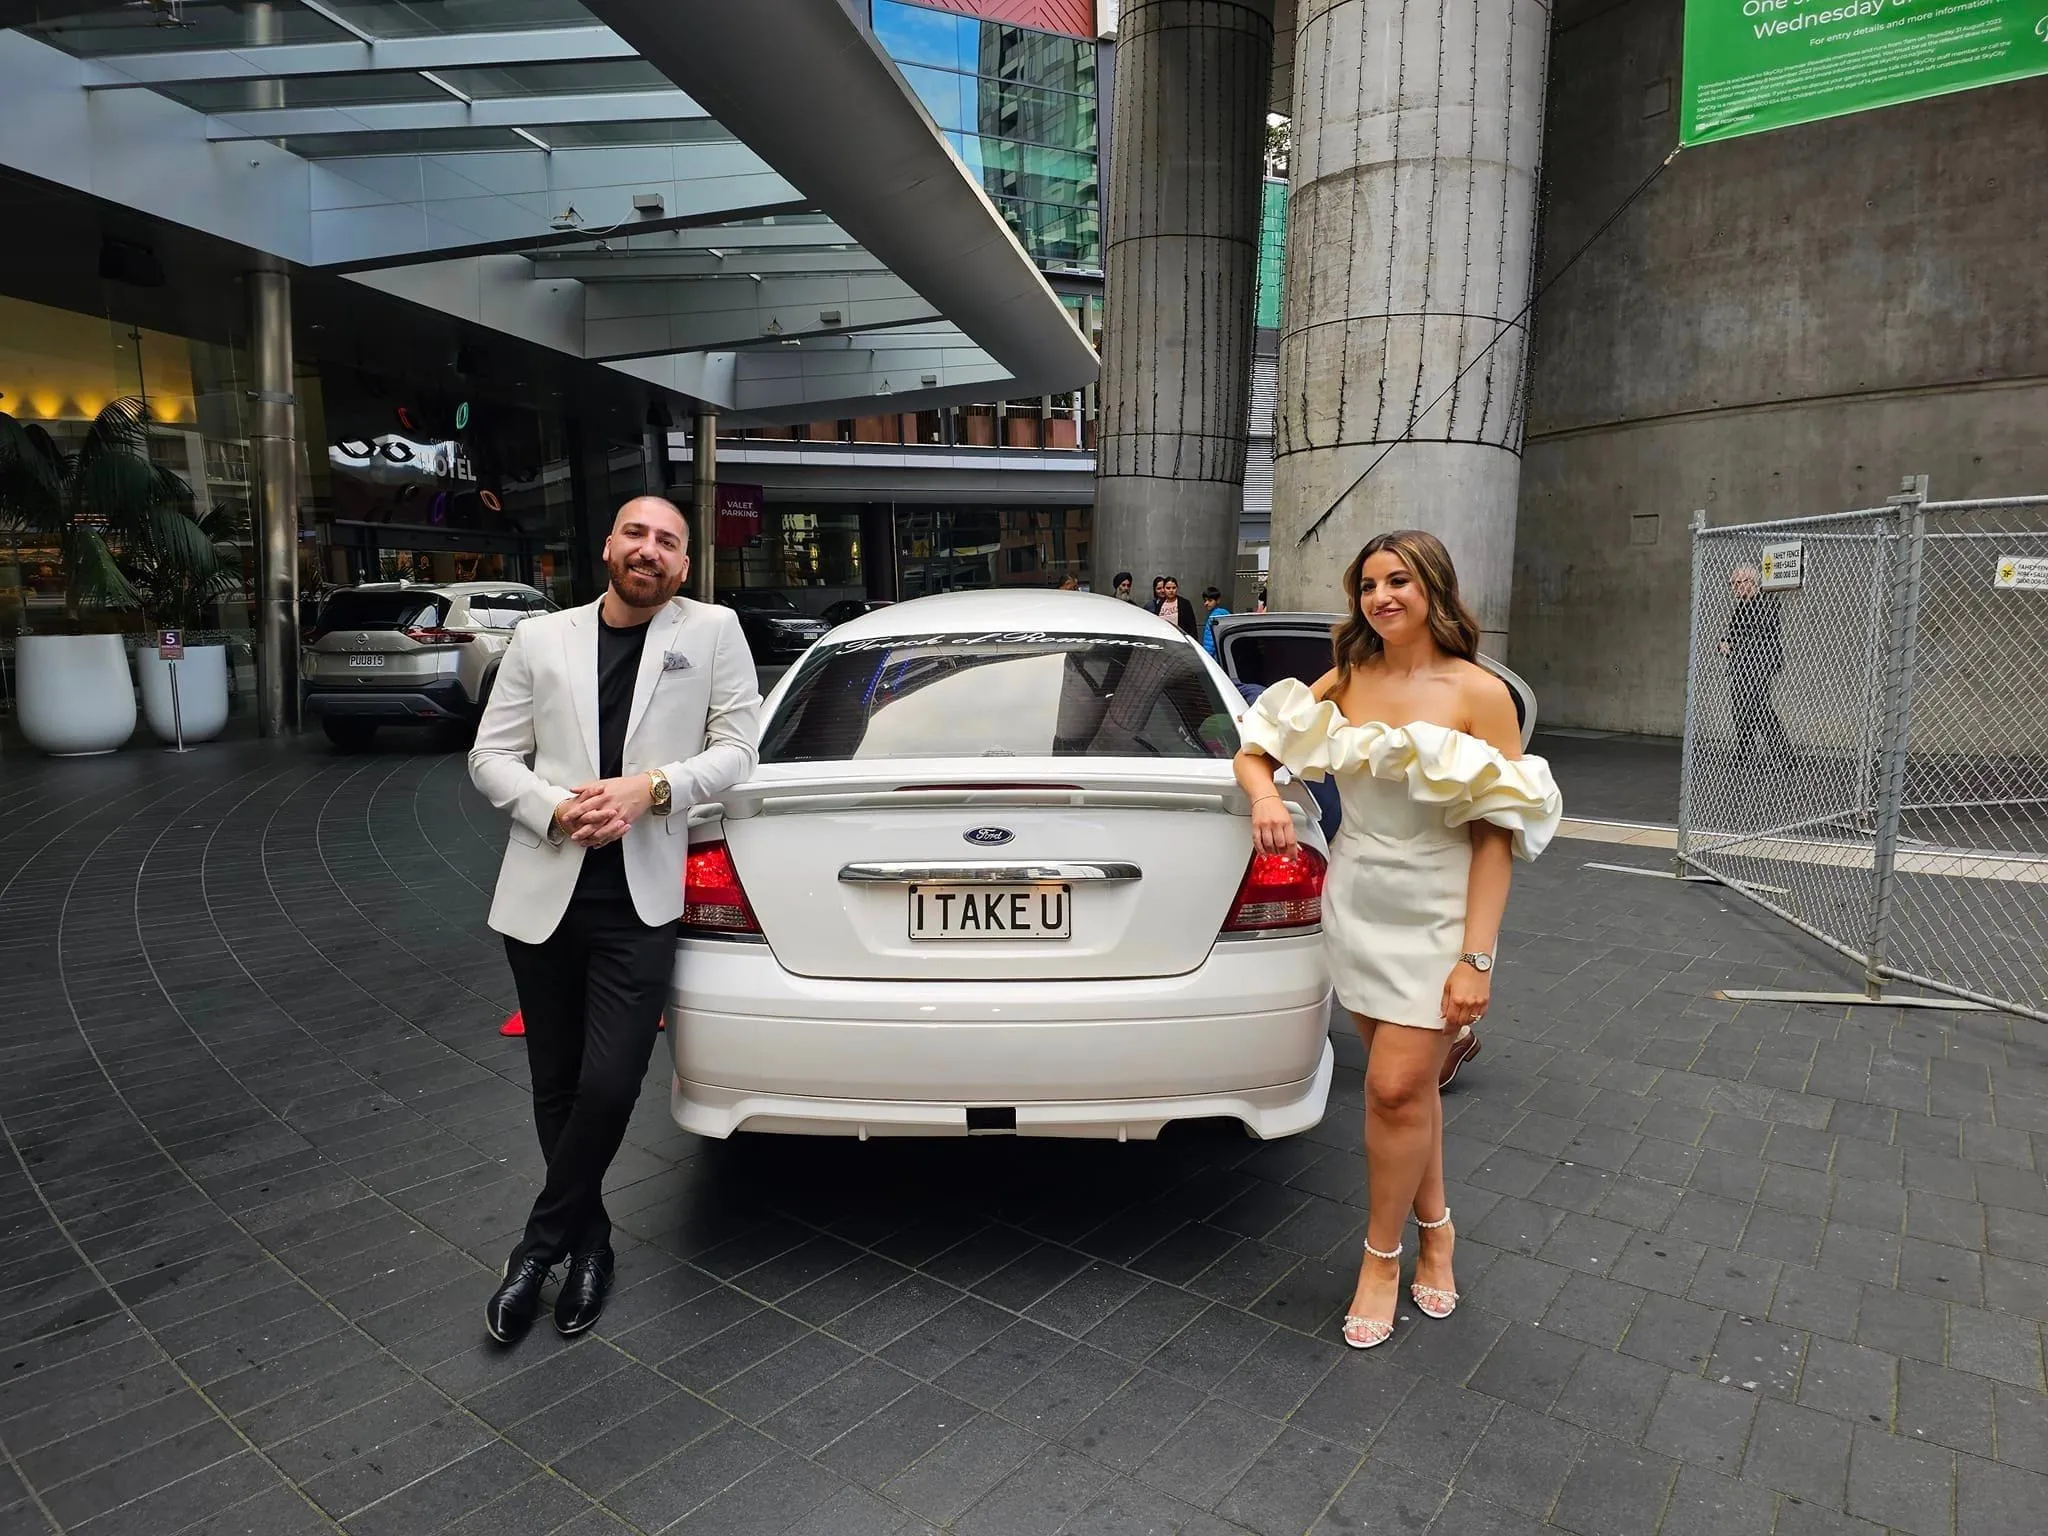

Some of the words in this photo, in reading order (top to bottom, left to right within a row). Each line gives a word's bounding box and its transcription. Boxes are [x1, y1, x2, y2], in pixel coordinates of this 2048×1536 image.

[1743, 0, 1787, 16] One
[1754, 0, 1884, 39] Wednesday
[1810, 37, 1824, 46] For
[1826, 32, 1852, 42] entry
[1853, 24, 1884, 36] details
[1886, 18, 1904, 28] and
[1908, 12, 1933, 23] more
[1936, 0, 1992, 16] information
[722, 509, 758, 518] PARKING
[165, 632, 176, 644] 5
[836, 636, 946, 654] Touch
[952, 632, 1002, 644] of
[996, 632, 1164, 650] Romance
[350, 655, 383, 666] PUU815
[976, 828, 1003, 840] Ford
